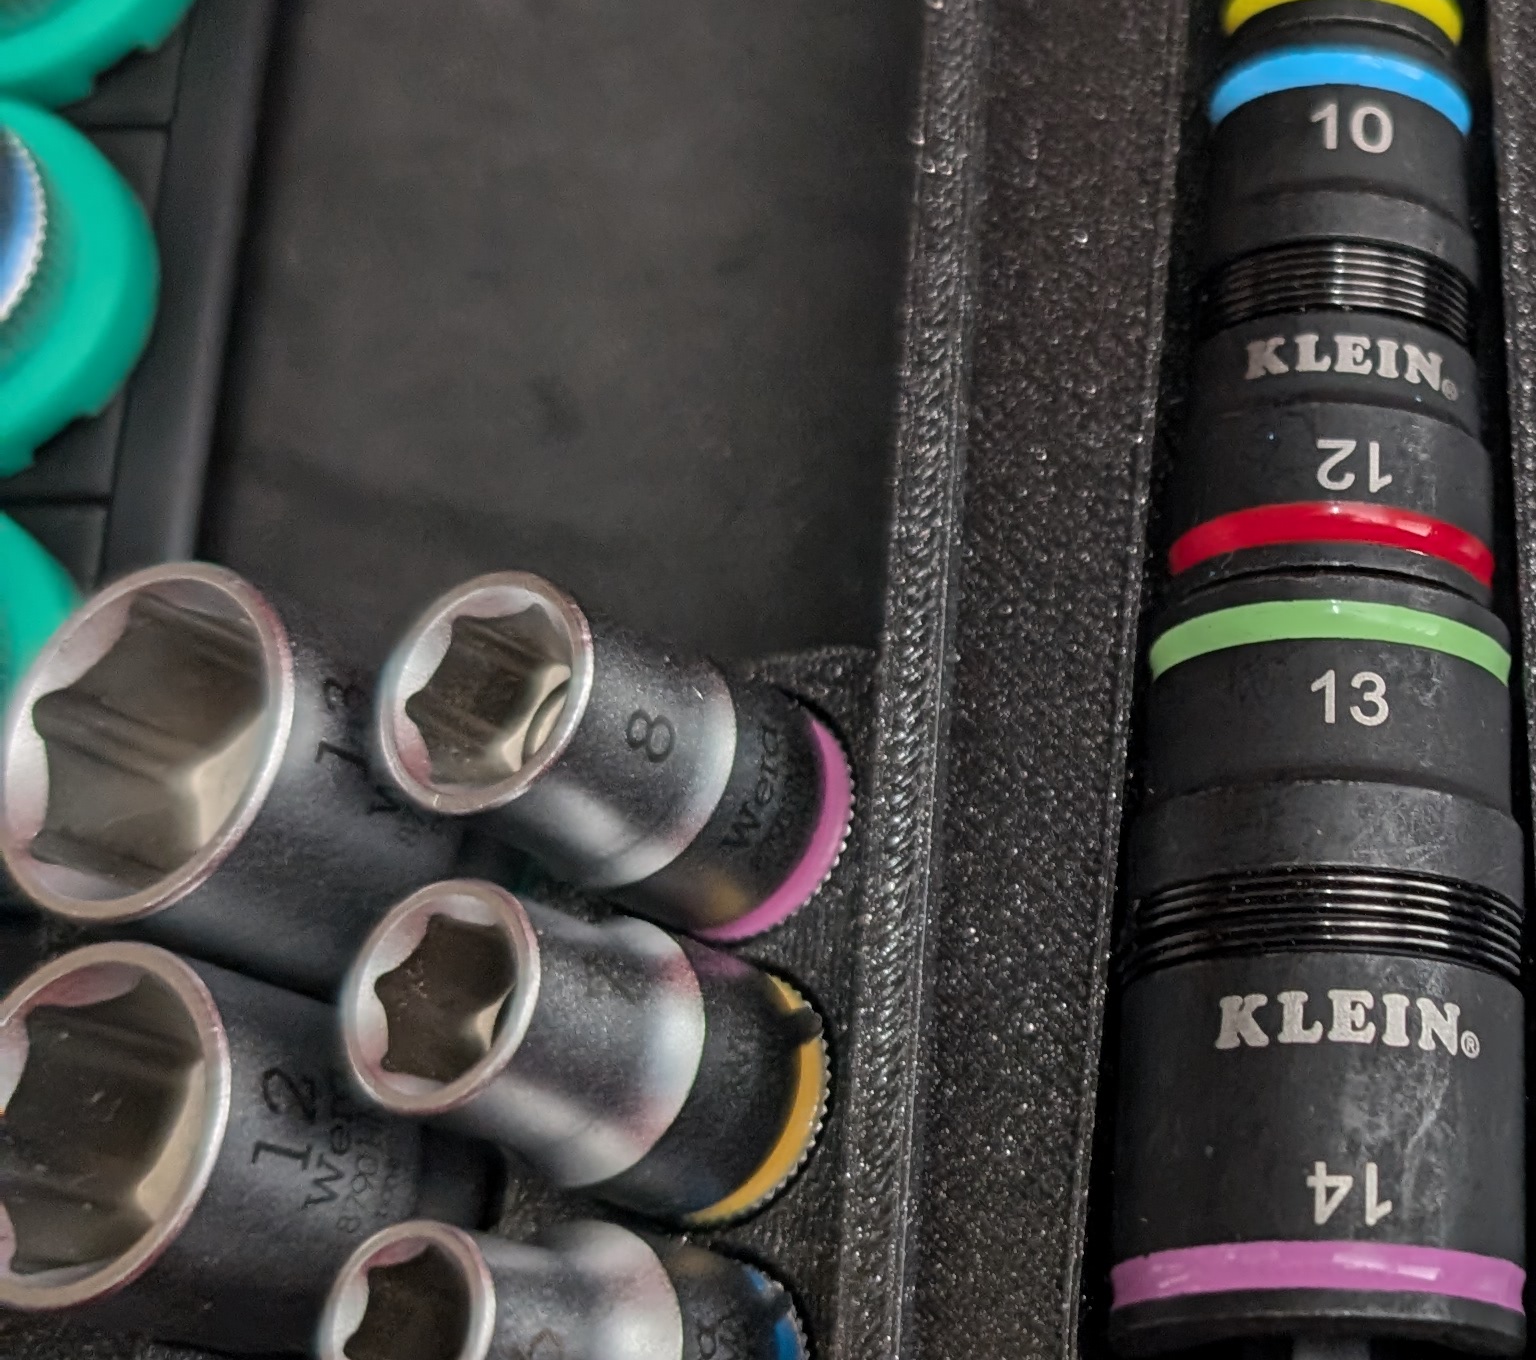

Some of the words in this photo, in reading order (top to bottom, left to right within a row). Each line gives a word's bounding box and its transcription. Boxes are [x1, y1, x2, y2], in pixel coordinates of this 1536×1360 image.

[1310, 102, 1395, 155] 10
[1316, 439, 1393, 494] 12
[1310, 669, 1390, 727] 13
[625, 709, 677, 764] 8
[250, 1065, 316, 1172] 12
[1306, 1160, 1393, 1226] 14
